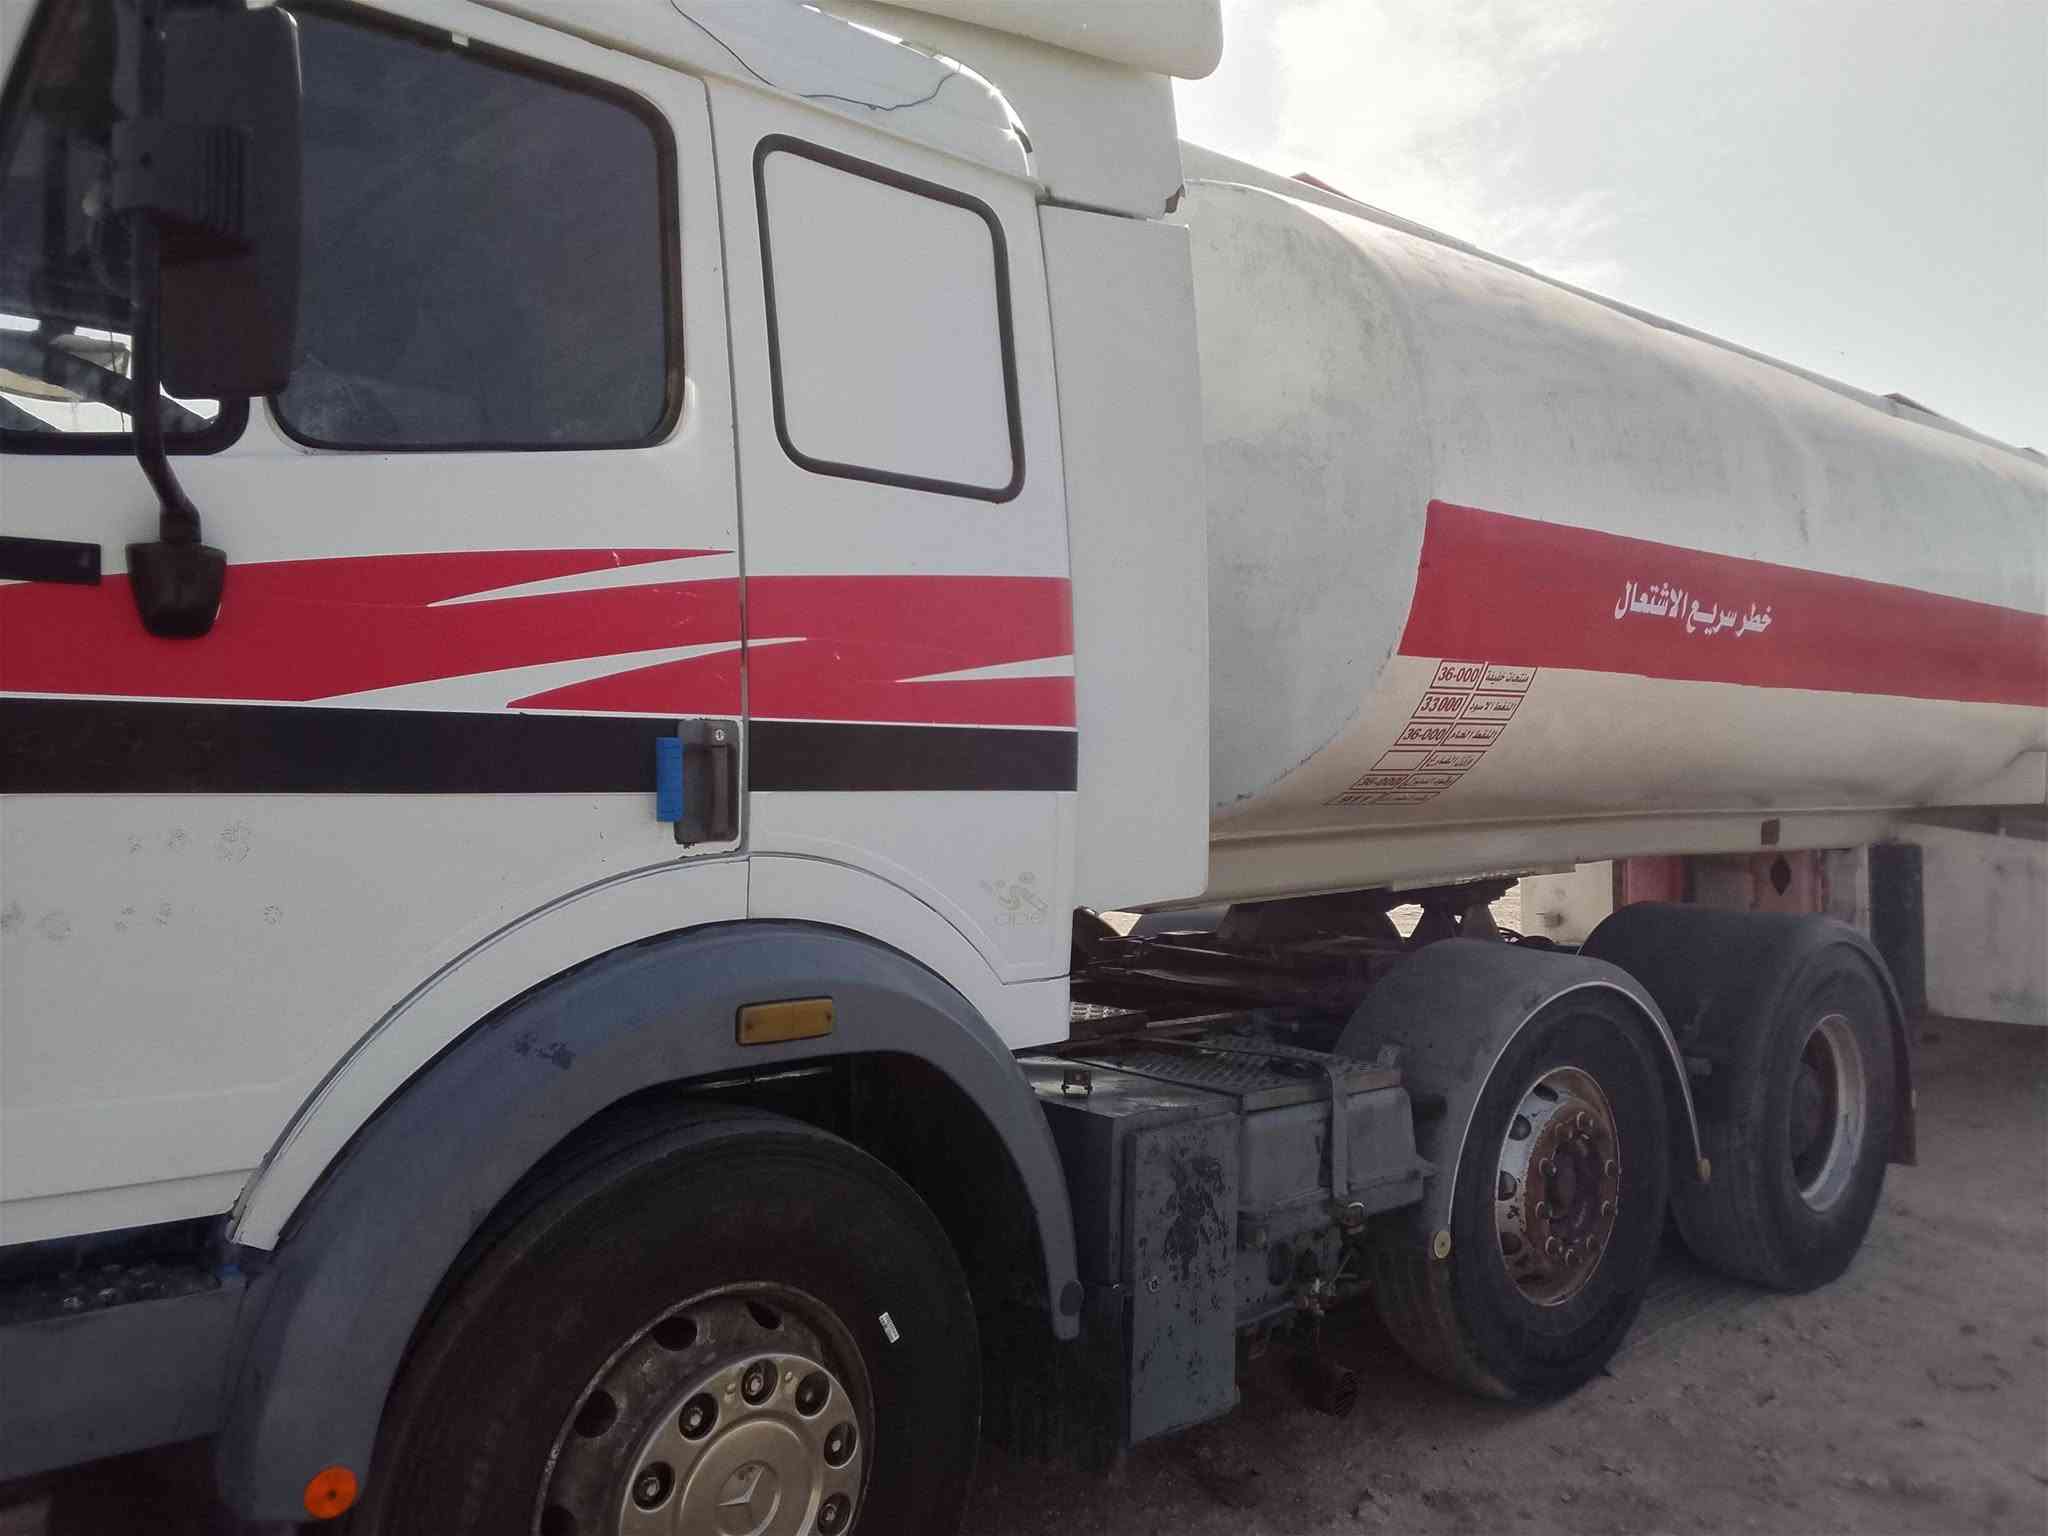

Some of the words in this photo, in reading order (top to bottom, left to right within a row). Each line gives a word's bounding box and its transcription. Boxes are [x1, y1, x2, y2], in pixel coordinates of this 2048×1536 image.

[1615, 580, 1689, 620] الاشتعال
[1686, 600, 1738, 634] سريع
[1735, 602, 1772, 637] خطر
